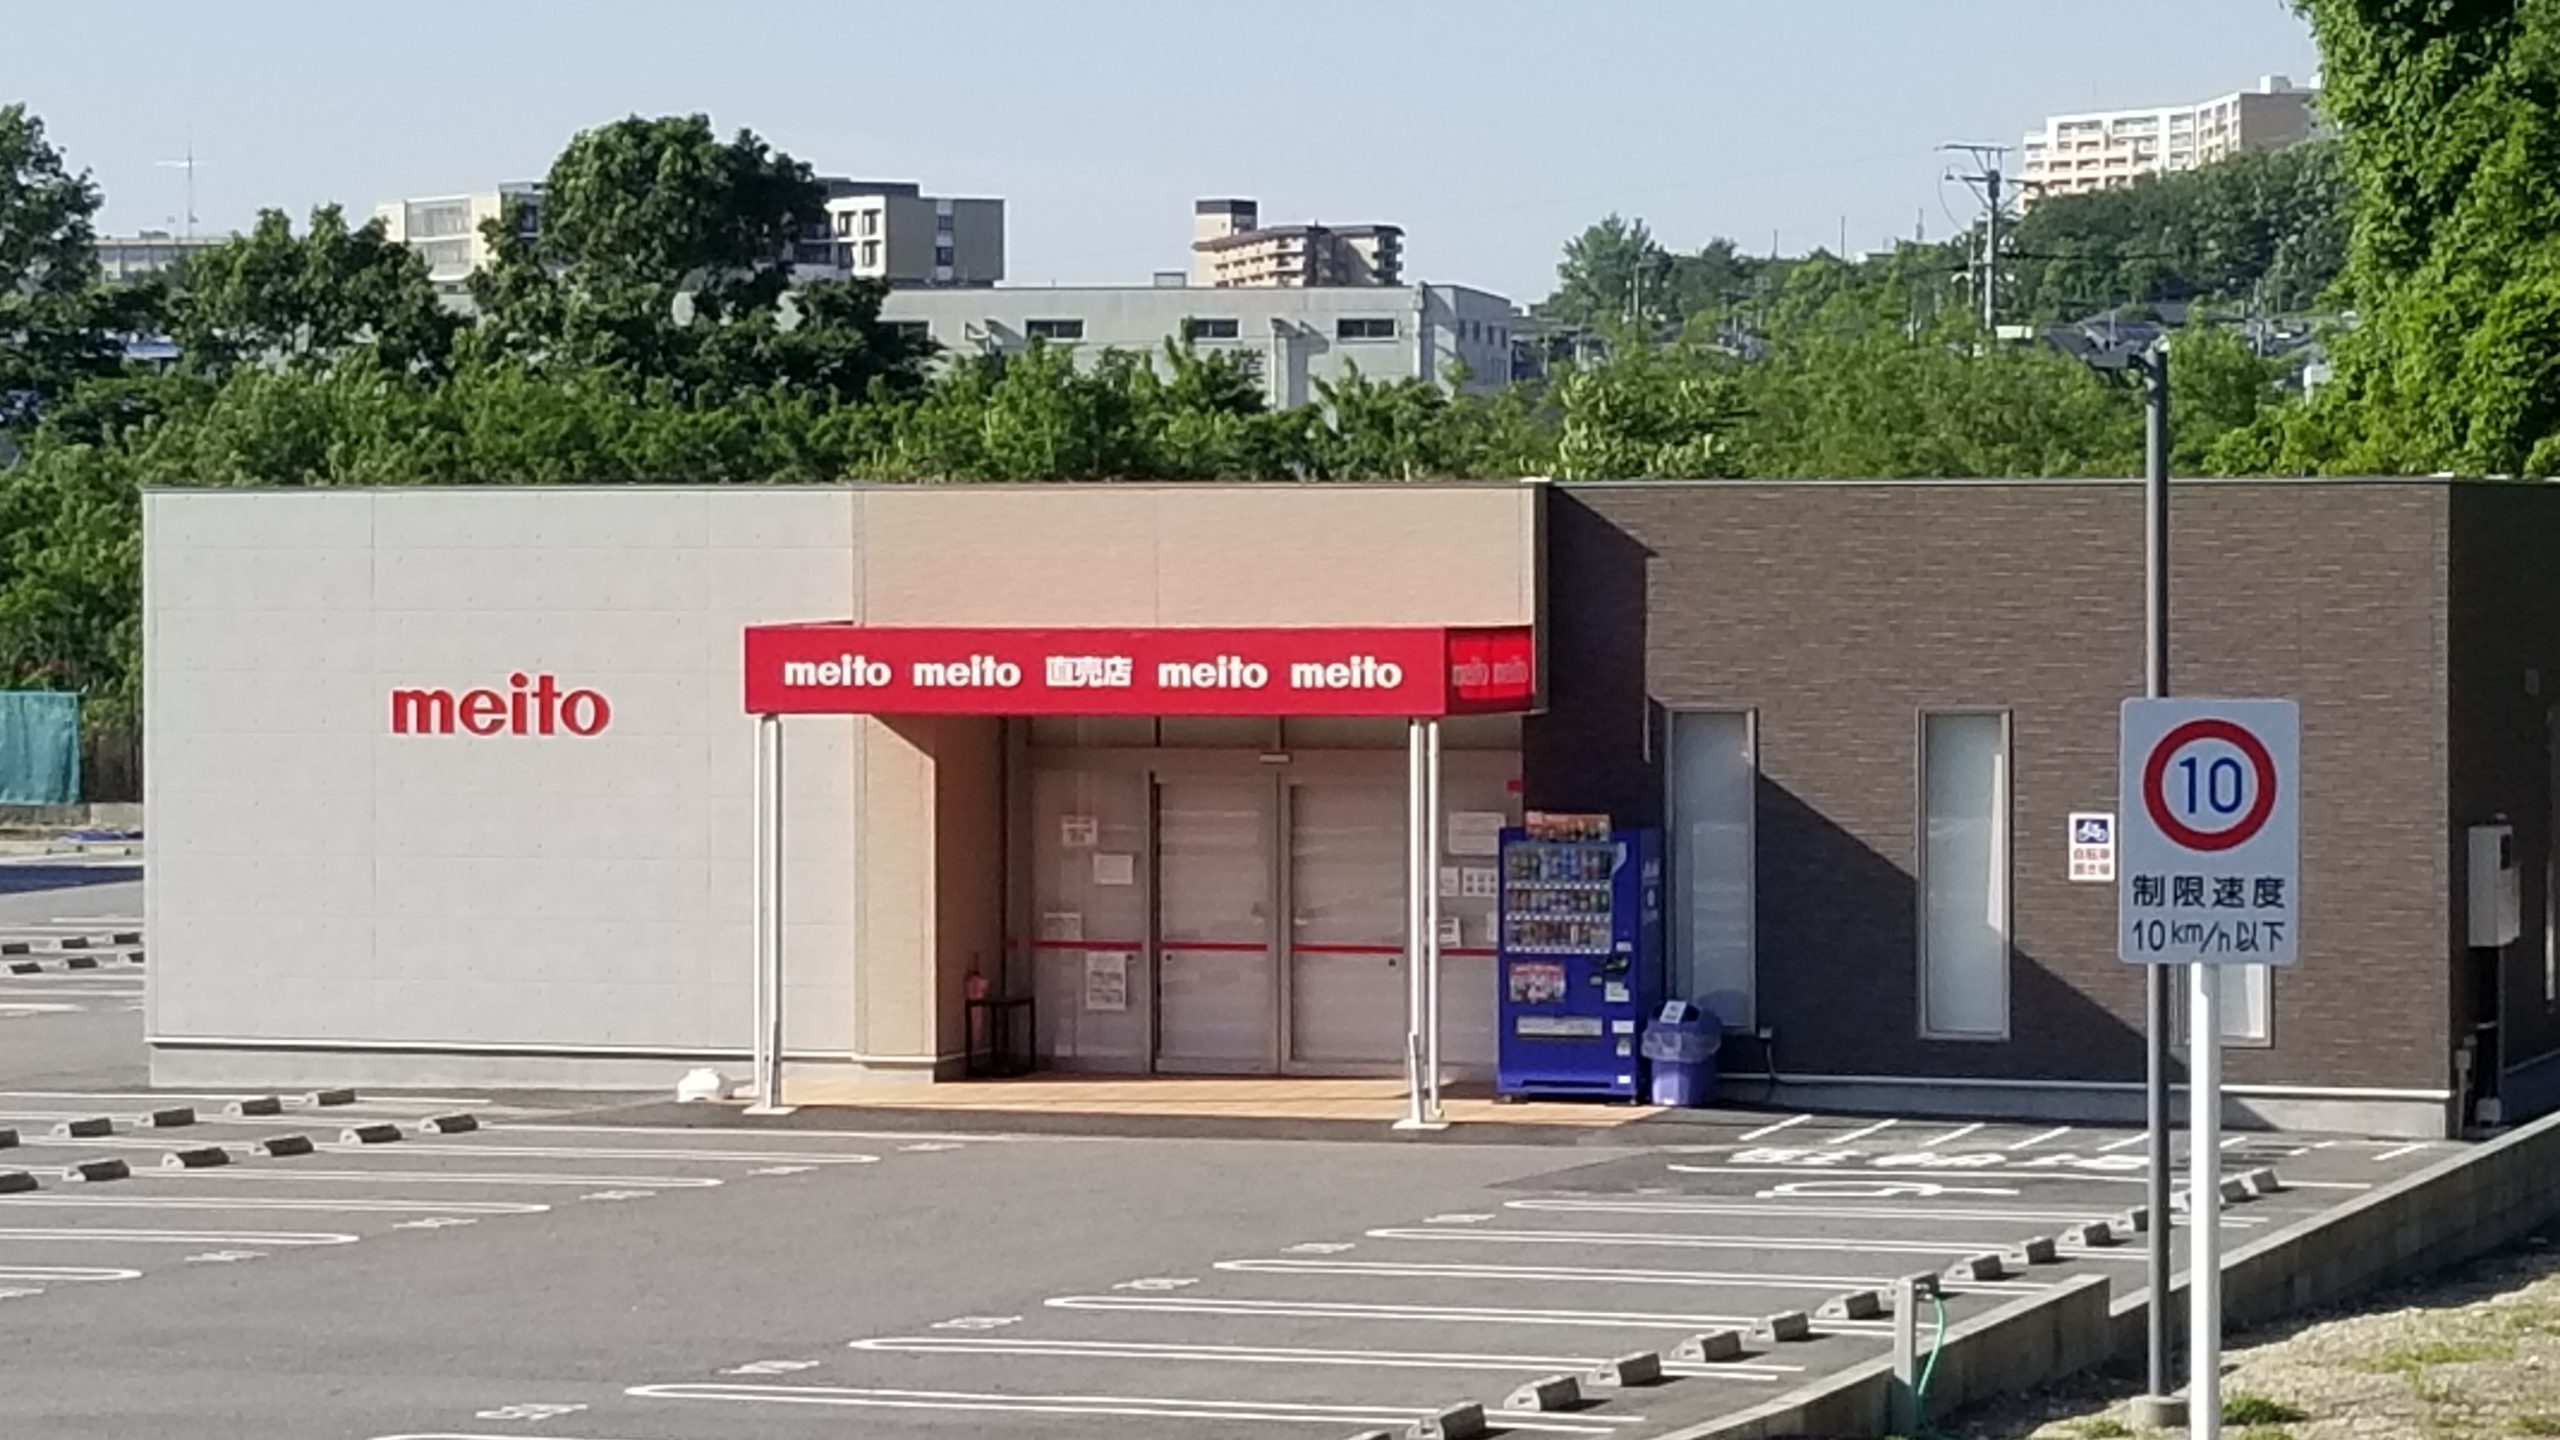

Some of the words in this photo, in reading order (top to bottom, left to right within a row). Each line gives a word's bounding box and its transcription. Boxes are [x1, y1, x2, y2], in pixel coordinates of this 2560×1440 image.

[784, 653, 892, 687] meito
[913, 654, 1022, 687] meito
[1045, 655, 1133, 687] 直売店
[1158, 655, 1268, 688] meito
[1291, 655, 1402, 688] meito
[392, 672, 611, 736] meito
[2179, 757, 2243, 814] 10
[2132, 874, 2286, 909] 制限速度
